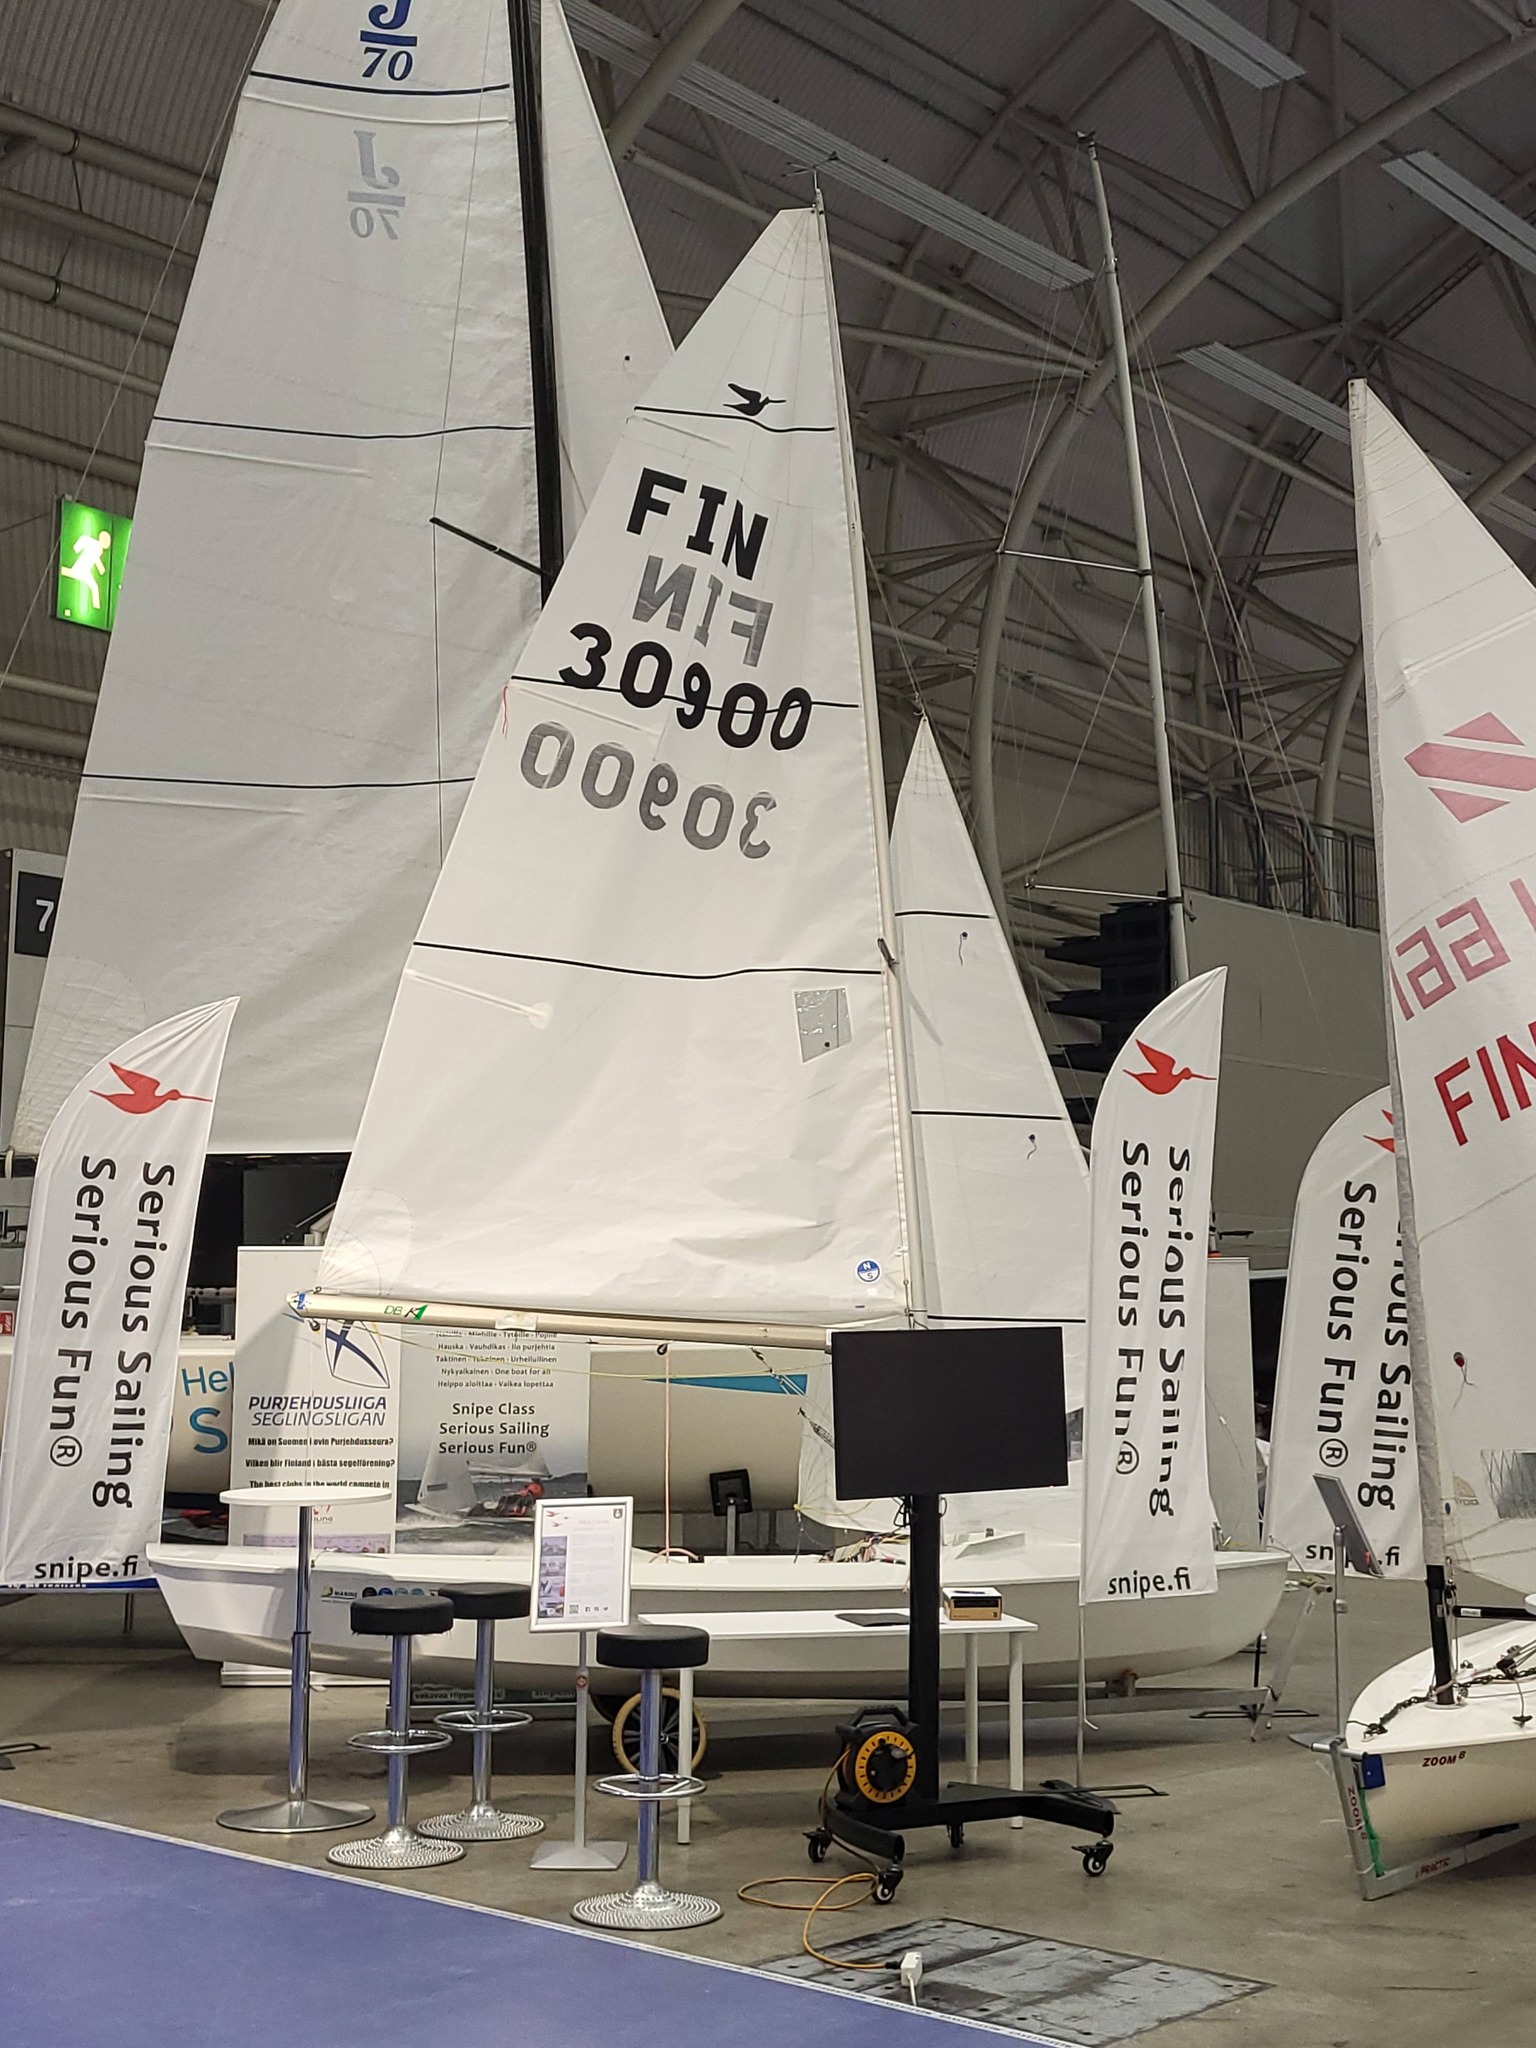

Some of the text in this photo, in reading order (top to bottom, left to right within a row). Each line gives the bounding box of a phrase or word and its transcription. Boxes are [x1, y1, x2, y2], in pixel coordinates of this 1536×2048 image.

[361, 46, 414, 82] 70
[626, 466, 769, 581] FIN
[558, 622, 812, 751] 30900
[35, 898, 55, 932] 7
[61, 1155, 117, 1329] Serious
[1118, 1139, 1150, 1327] Serious
[1326, 1179, 1377, 1342] Serious
[92, 1161, 176, 1509] Serious Sailing
[1149, 1146, 1194, 1517] Serious Sailing
[511, 1367, 528, 1375] boat
[529, 1367, 540, 1375] for
[248, 1396, 388, 1411] PURJEHDUSLIIGA
[251, 1411, 386, 1427] SEGLINGSLIGAN
[452, 1402, 536, 1418] Snipe Class
[277, 1437, 308, 1446] Suomen
[439, 1421, 550, 1438] Serious Sailing
[1357, 1361, 1412, 1511] Sailing
[245, 1458, 269, 1467] Vilken
[438, 1441, 495, 1454] Serious
[33, 1554, 139, 1585] snipe.fi
[1305, 1544, 1401, 1569] sn.fi
[1107, 1566, 1192, 1599] snipe.fi
